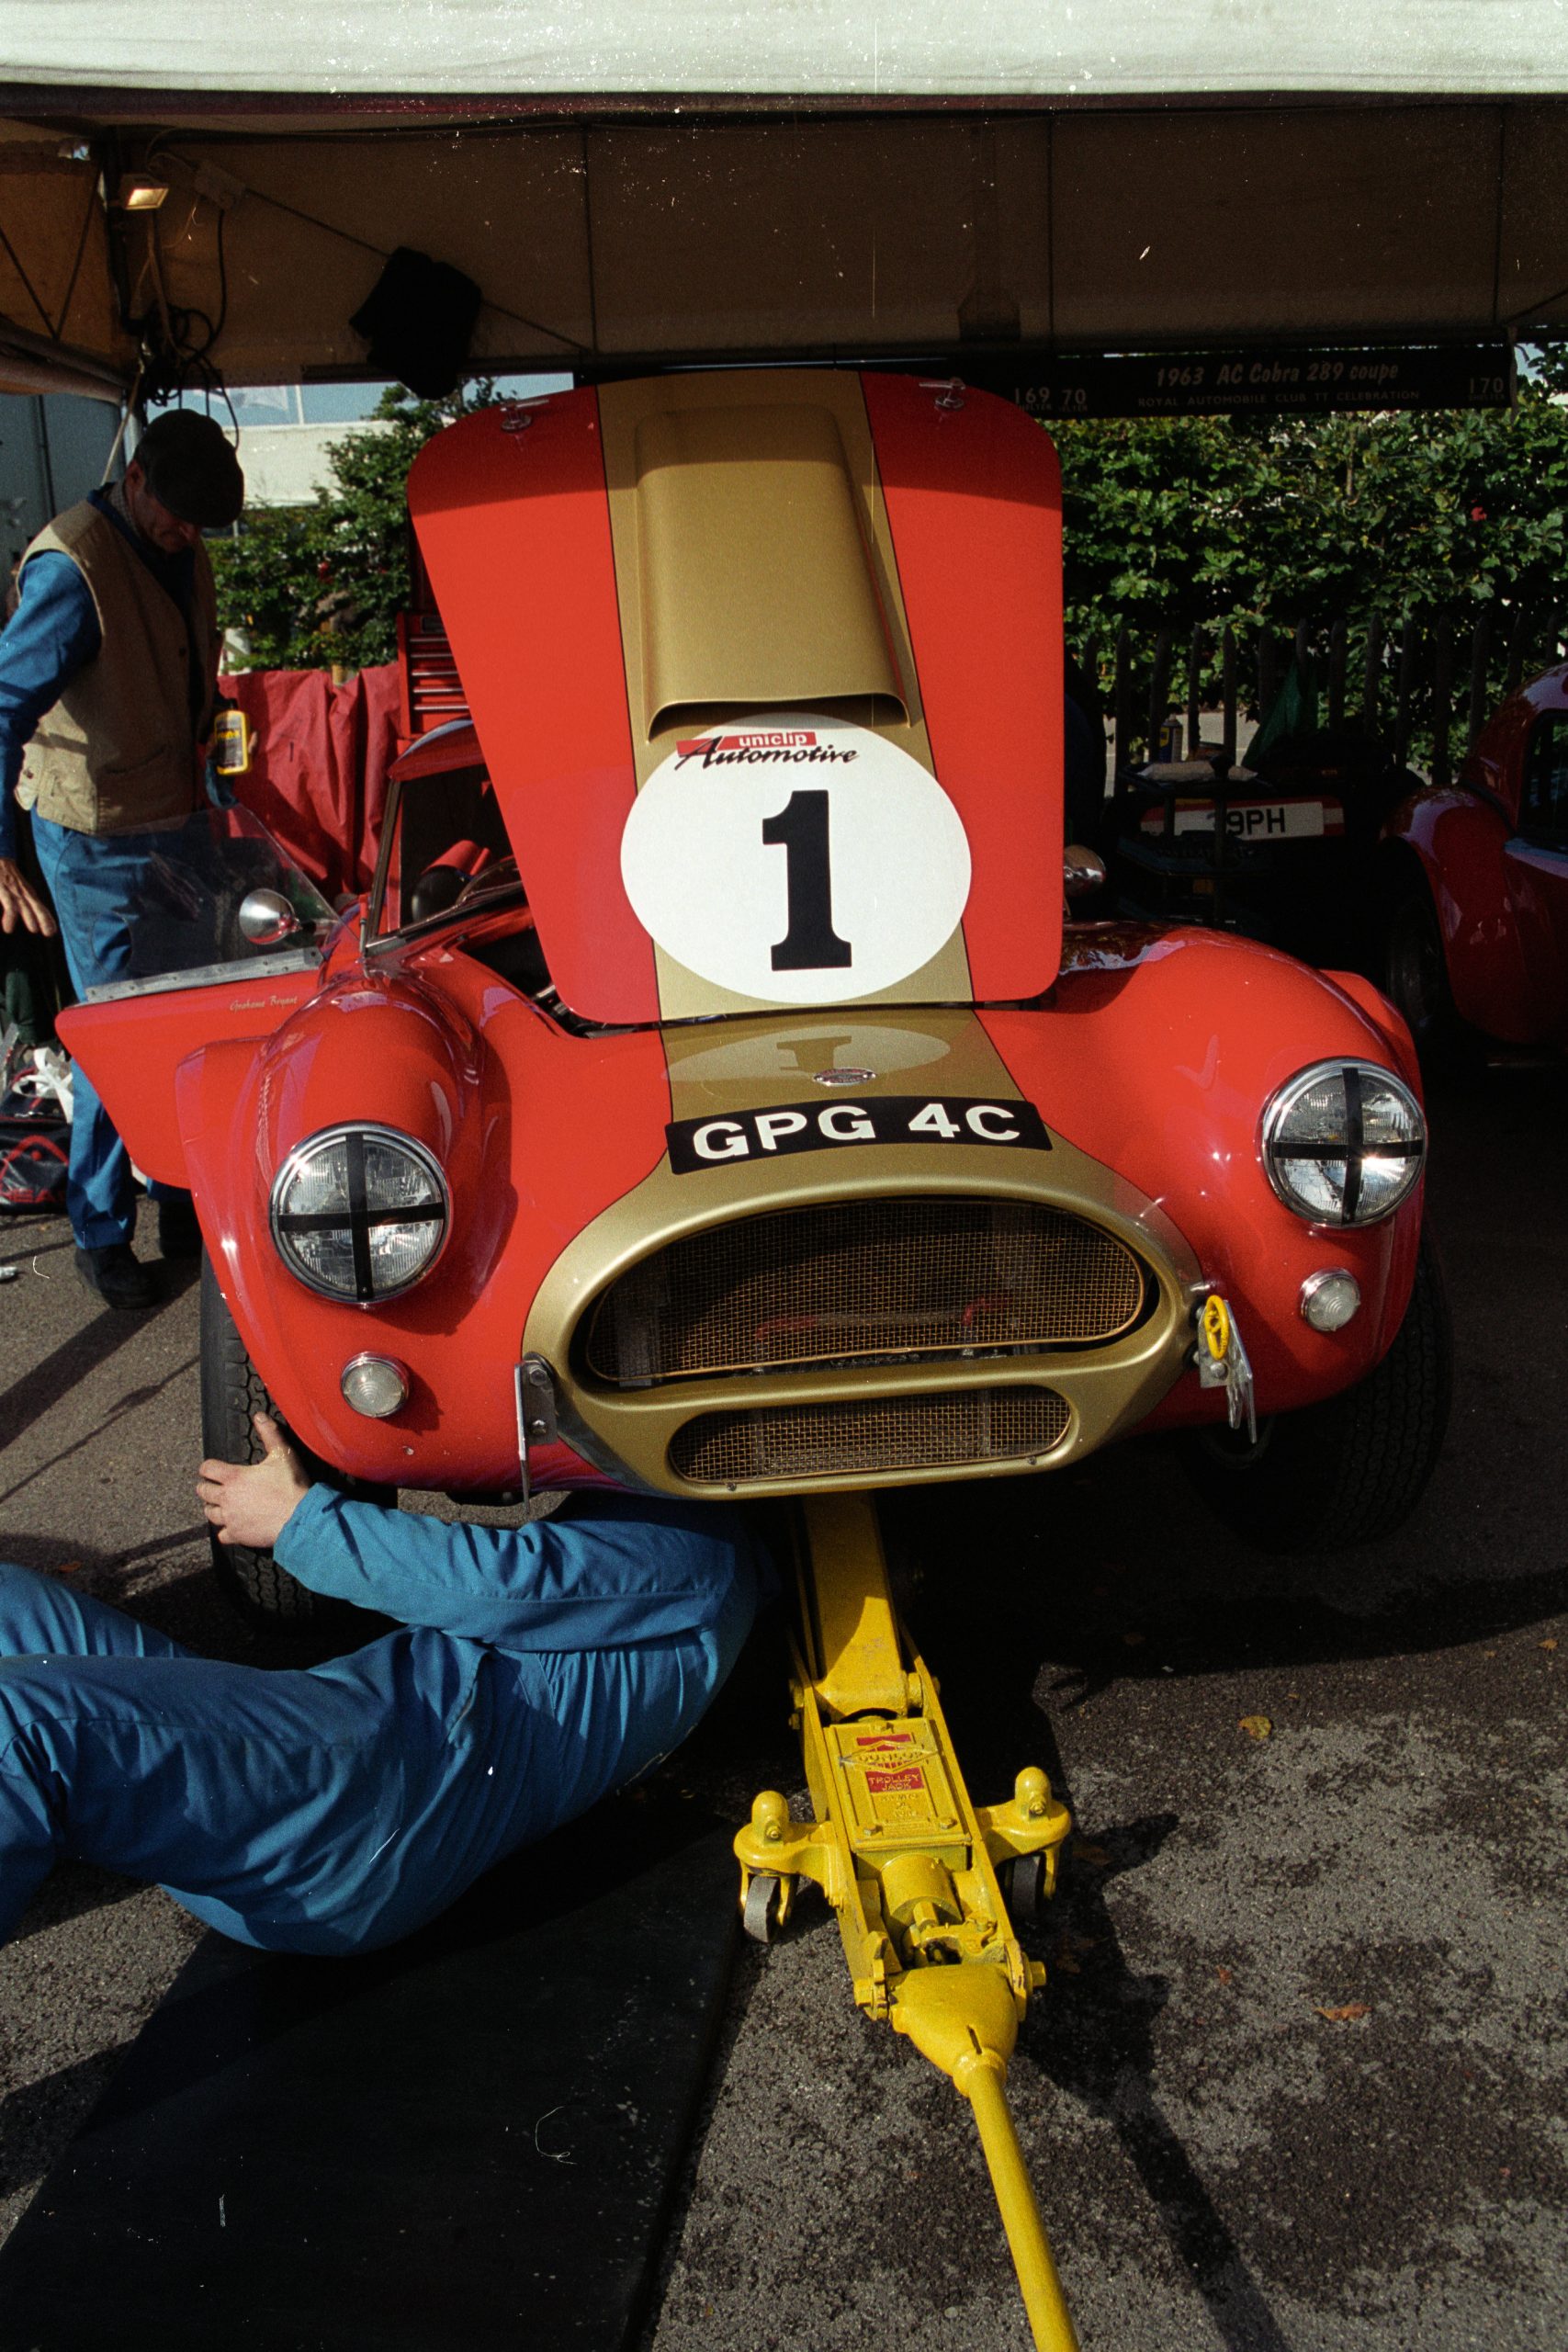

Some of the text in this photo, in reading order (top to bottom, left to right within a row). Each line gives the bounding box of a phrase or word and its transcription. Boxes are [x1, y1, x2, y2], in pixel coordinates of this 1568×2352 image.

[1157, 359, 1399, 388] 1963 AC Cobra 289 coupe
[1470, 375, 1505, 394] 170
[1014, 385, 1051, 404] 169
[1138, 390, 1419, 408] ROYAL AUTOMOBILE CLUB TT CELEBRATION
[739, 732, 807, 748] uniclip
[674, 736, 863, 771] Automotive
[761, 788, 852, 972] 1
[693, 1103, 1021, 1159] GPG 4C
[868, 1773, 919, 1787] TROLLEY
[882, 1780, 912, 1792] JACK
